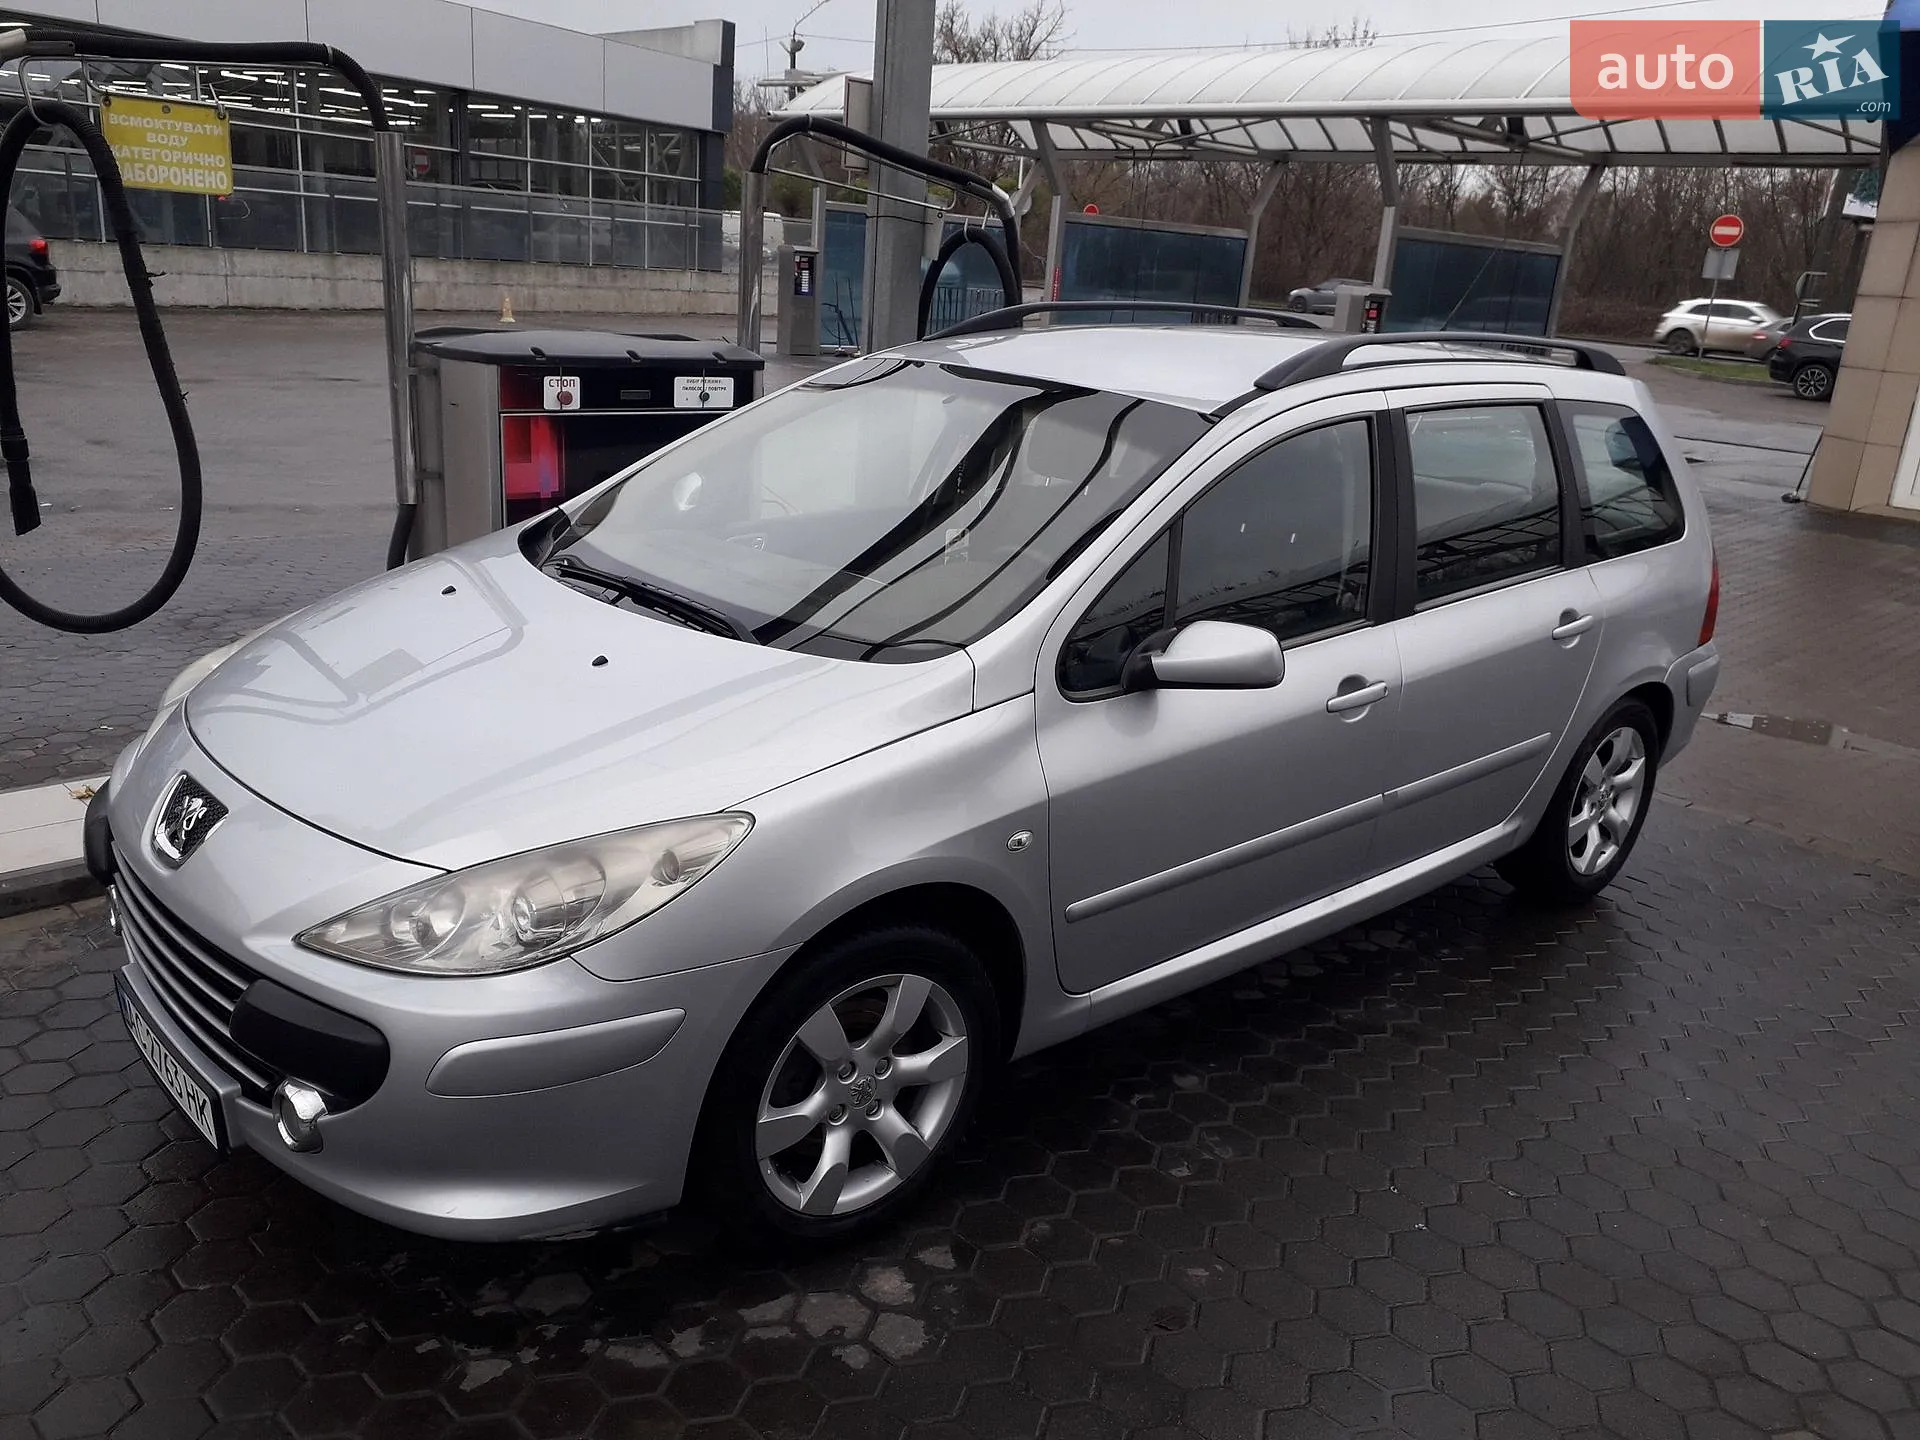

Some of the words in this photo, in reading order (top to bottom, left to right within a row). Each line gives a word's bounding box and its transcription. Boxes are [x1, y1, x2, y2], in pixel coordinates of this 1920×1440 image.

[109, 113, 223, 136] ВСМОКТУВАТИ
[146, 132, 188, 147] ВОДУ
[121, 162, 228, 189] АБОРОНЕНО
[549, 379, 576, 388] СТОП
[183, 1073, 214, 1138] HK
